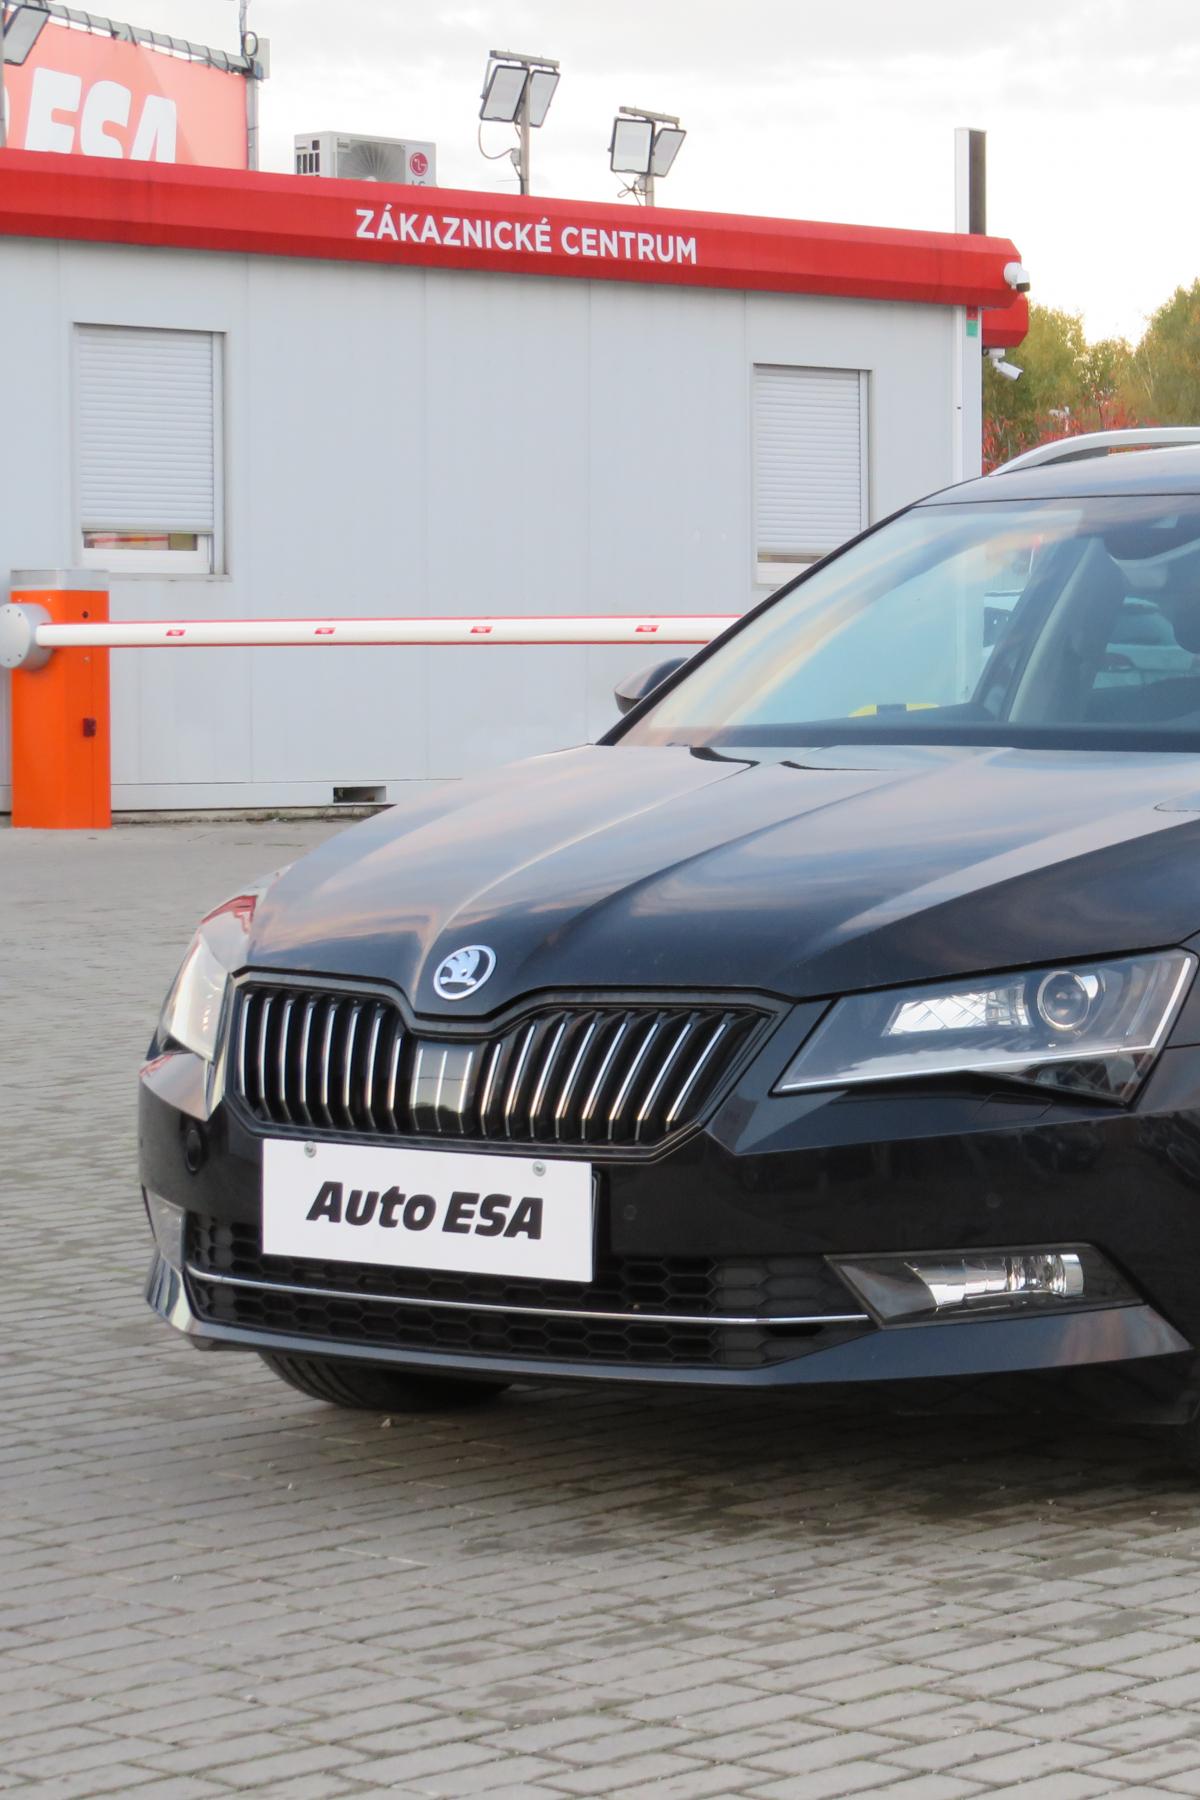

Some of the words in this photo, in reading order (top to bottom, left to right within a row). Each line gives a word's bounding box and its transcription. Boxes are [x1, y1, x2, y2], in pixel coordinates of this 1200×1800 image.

[355, 203, 552, 253] ZÁKAZNICKÉ
[561, 226, 697, 265] CENTRUM
[306, 1180, 437, 1231] Auto
[442, 1191, 543, 1240] ESA
